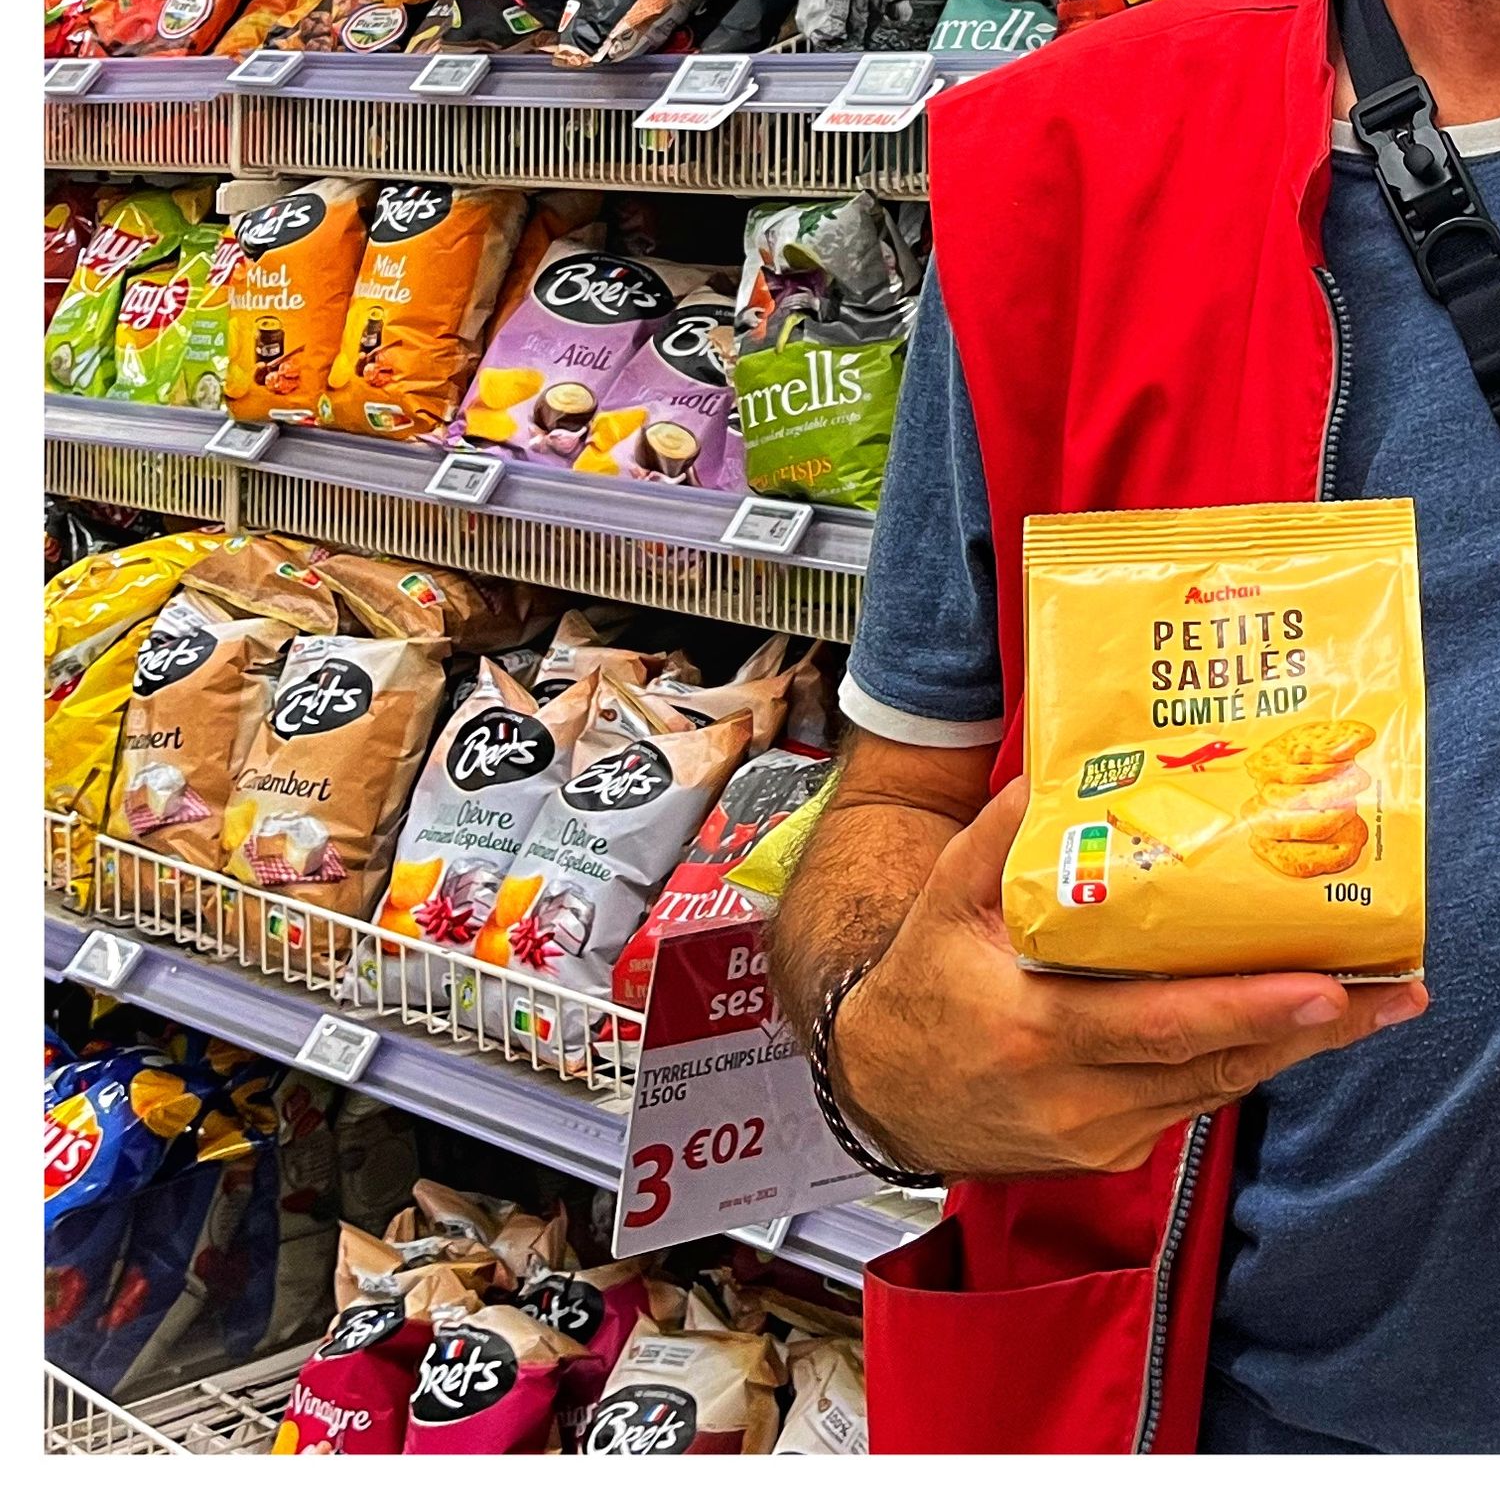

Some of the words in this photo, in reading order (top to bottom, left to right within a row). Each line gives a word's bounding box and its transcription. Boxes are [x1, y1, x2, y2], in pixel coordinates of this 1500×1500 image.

[246, 263, 291, 289] Miel
[373, 253, 408, 280] Miel
[554, 343, 613, 371] Aïoli
[739, 350, 863, 429] rrells
[1184, 583, 1261, 605] Auchan
[1153, 609, 1304, 652] PETITS
[1151, 644, 1306, 692] SABLÉS
[1152, 688, 1246, 729] COMTÉ
[1256, 684, 1307, 719] AOP
[1323, 882, 1372, 907] 100g
[709, 985, 764, 1021] ses
[642, 1056, 712, 1088] TYRRELLS
[715, 1048, 755, 1072] CHIPS
[638, 1084, 686, 1110] 150G
